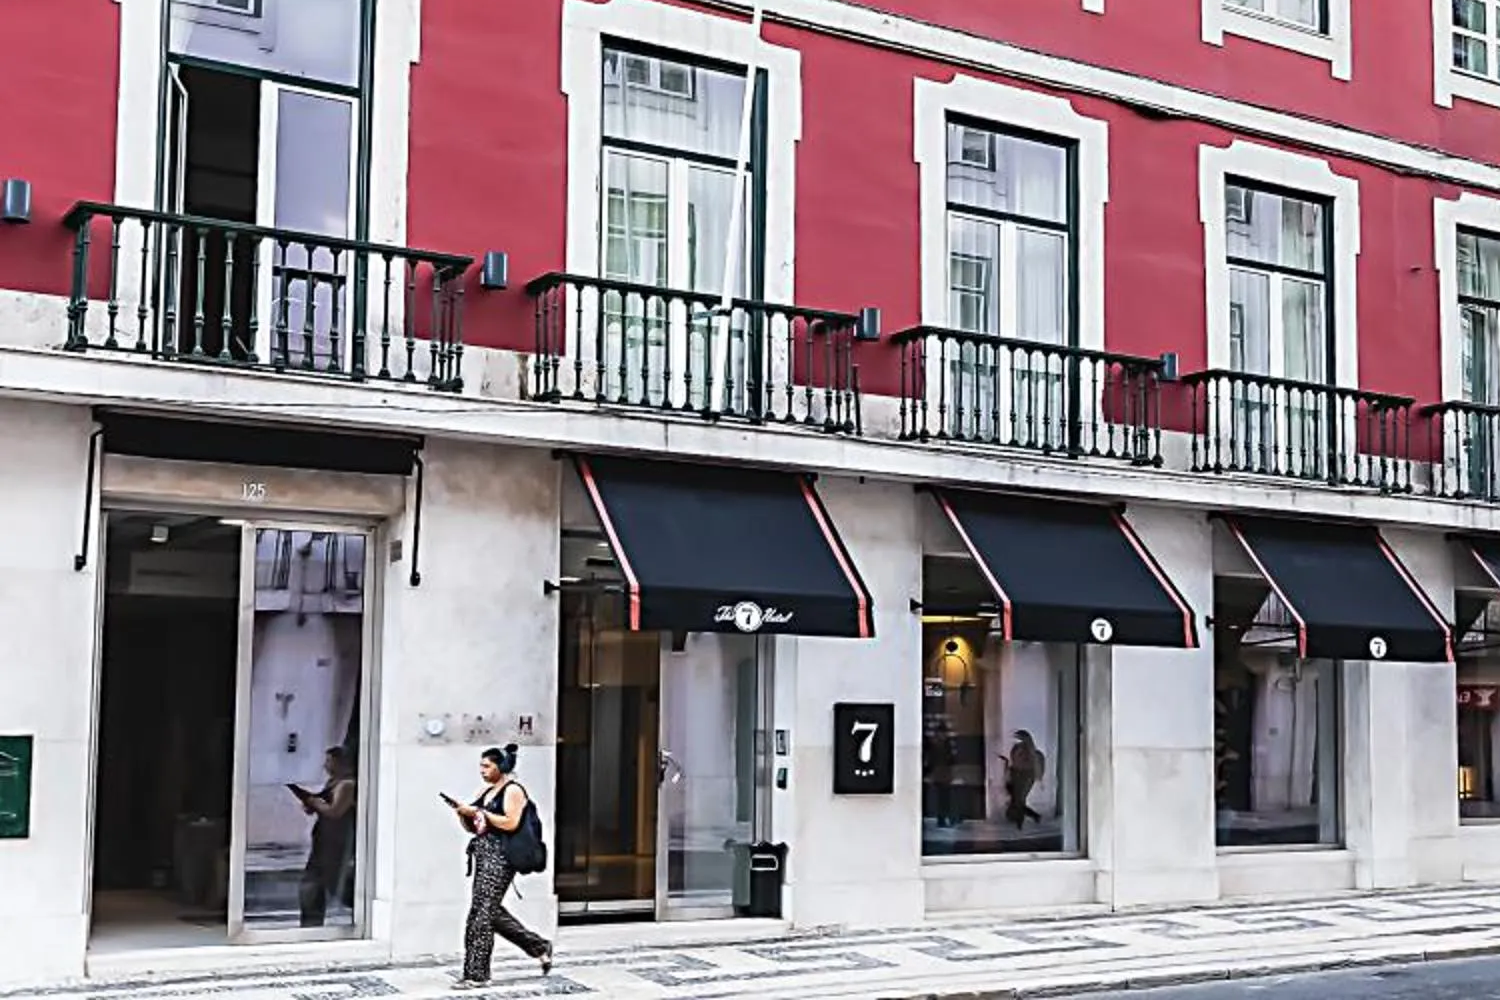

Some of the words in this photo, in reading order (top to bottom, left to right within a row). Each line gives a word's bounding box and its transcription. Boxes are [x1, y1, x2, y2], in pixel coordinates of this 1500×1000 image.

[242, 483, 265, 501] 125
[519, 716, 533, 730] H
[850, 720, 879, 762] 7
